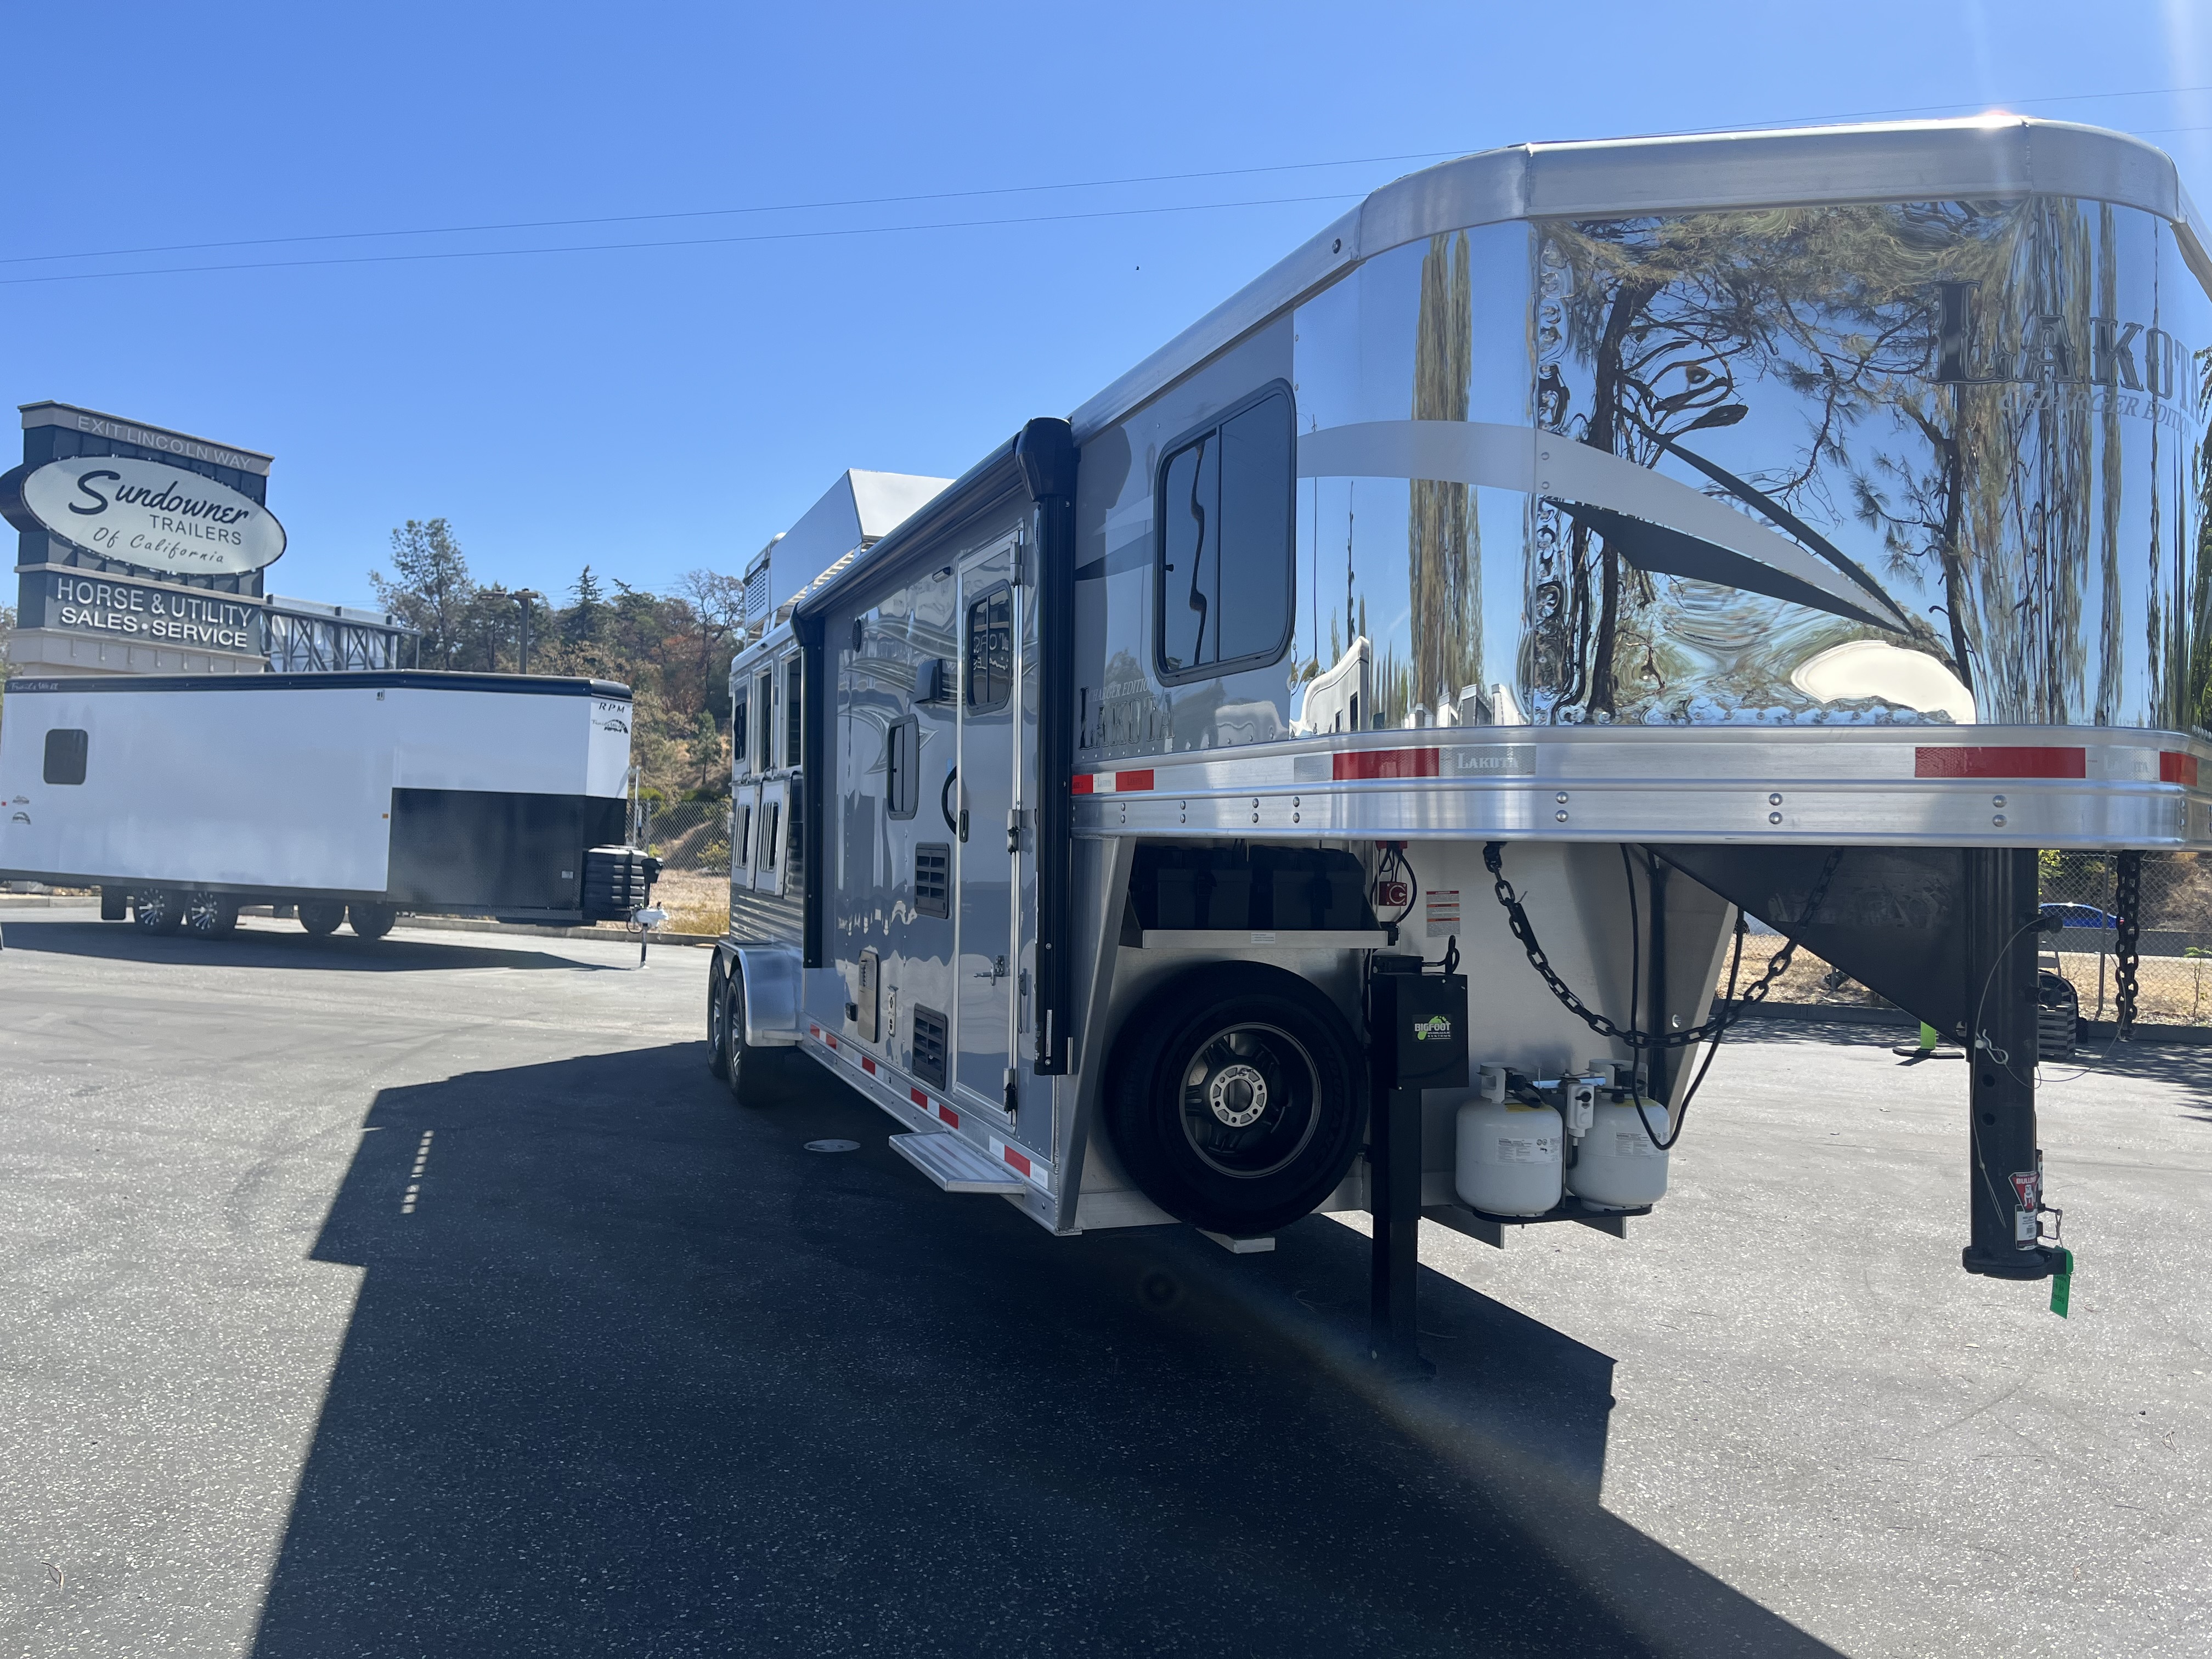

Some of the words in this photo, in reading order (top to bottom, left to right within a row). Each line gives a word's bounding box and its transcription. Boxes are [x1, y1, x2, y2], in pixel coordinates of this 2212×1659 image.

[1927, 280, 2202, 427] LAKOTA
[1999, 389, 2139, 417] CHARGER
[2142, 399, 2193, 439] EDITION
[78, 415, 122, 437] EXIT
[127, 427, 208, 460] LINCOLN
[213, 449, 251, 470] WAY
[68, 470, 249, 524] Sundowner
[93, 527, 120, 548] Of
[130, 534, 224, 563] California
[149, 514, 242, 545] TRAILERS
[57, 577, 144, 612] HORSE
[151, 593, 166, 614] &
[171, 596, 252, 628] UTILITY
[61, 606, 138, 632] SALES
[152, 619, 247, 647] SERVICE
[599, 702, 625, 713] RPM
[1089, 684, 1121, 702] CHARGER
[1122, 676, 1155, 696] EDITION
[1078, 686, 1175, 751] LAKOTA
[1457, 753, 1519, 769] LAKOTA
[1414, 1023, 1451, 1031] BIGFOOT
